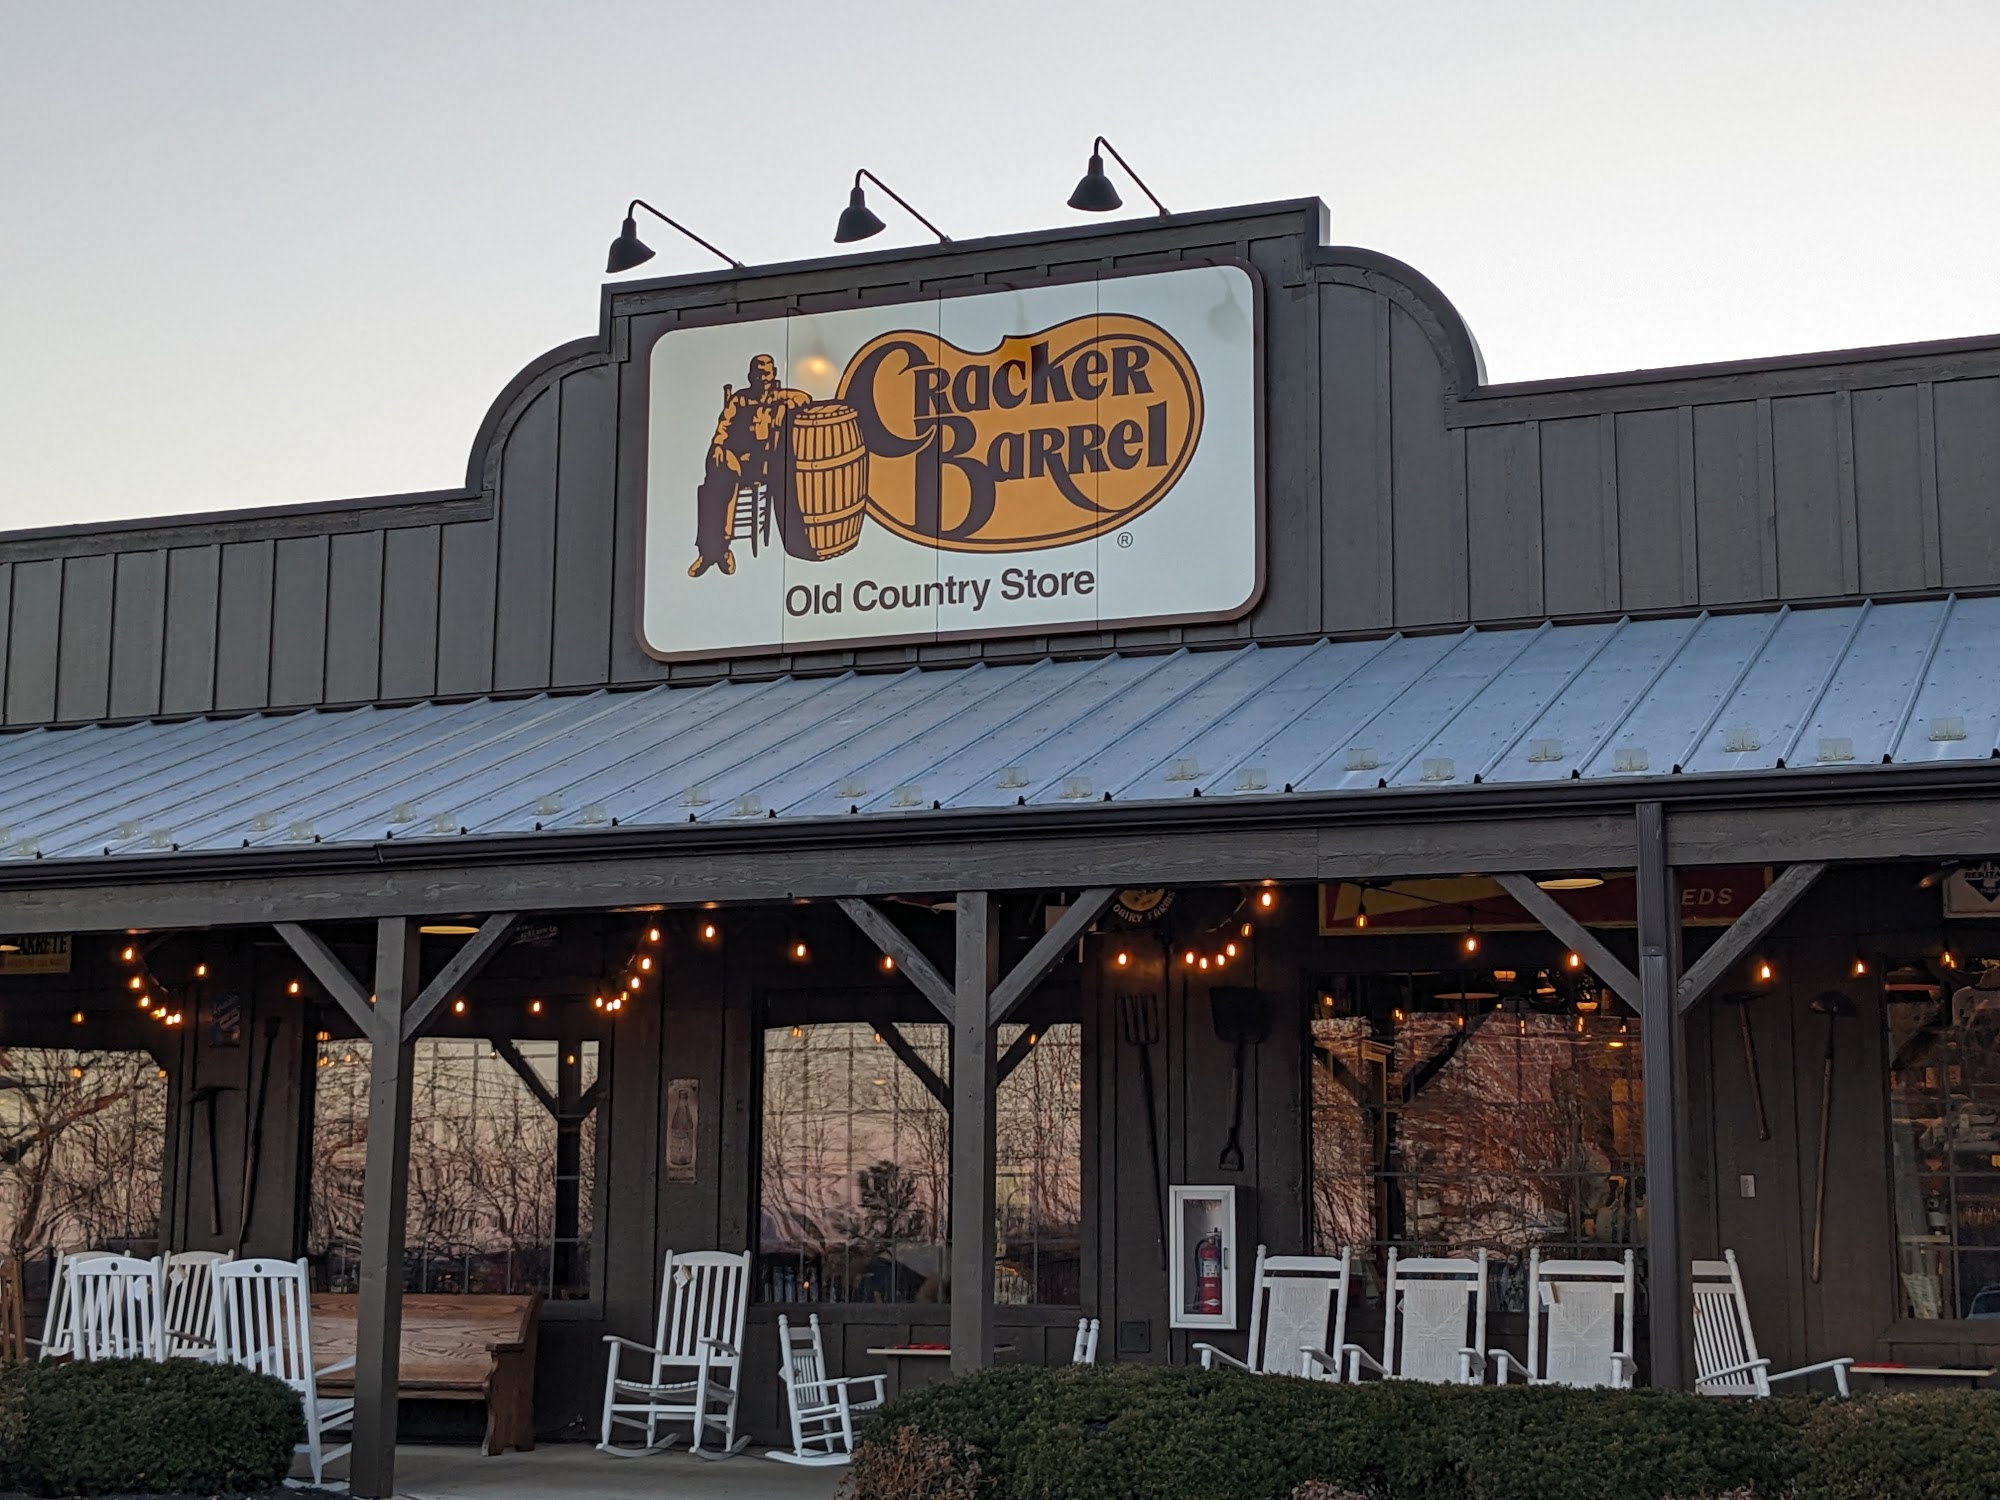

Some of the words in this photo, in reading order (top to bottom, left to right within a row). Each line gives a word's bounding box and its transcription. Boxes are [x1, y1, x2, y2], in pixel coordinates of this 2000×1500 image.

[786, 582, 842, 617] Old
[853, 575, 991, 612] Country
[1001, 567, 1095, 600] Store
[1113, 904, 1143, 922] DAIRY
[1148, 890, 1176, 920] FARMS
[1681, 887, 1733, 906] EDS
